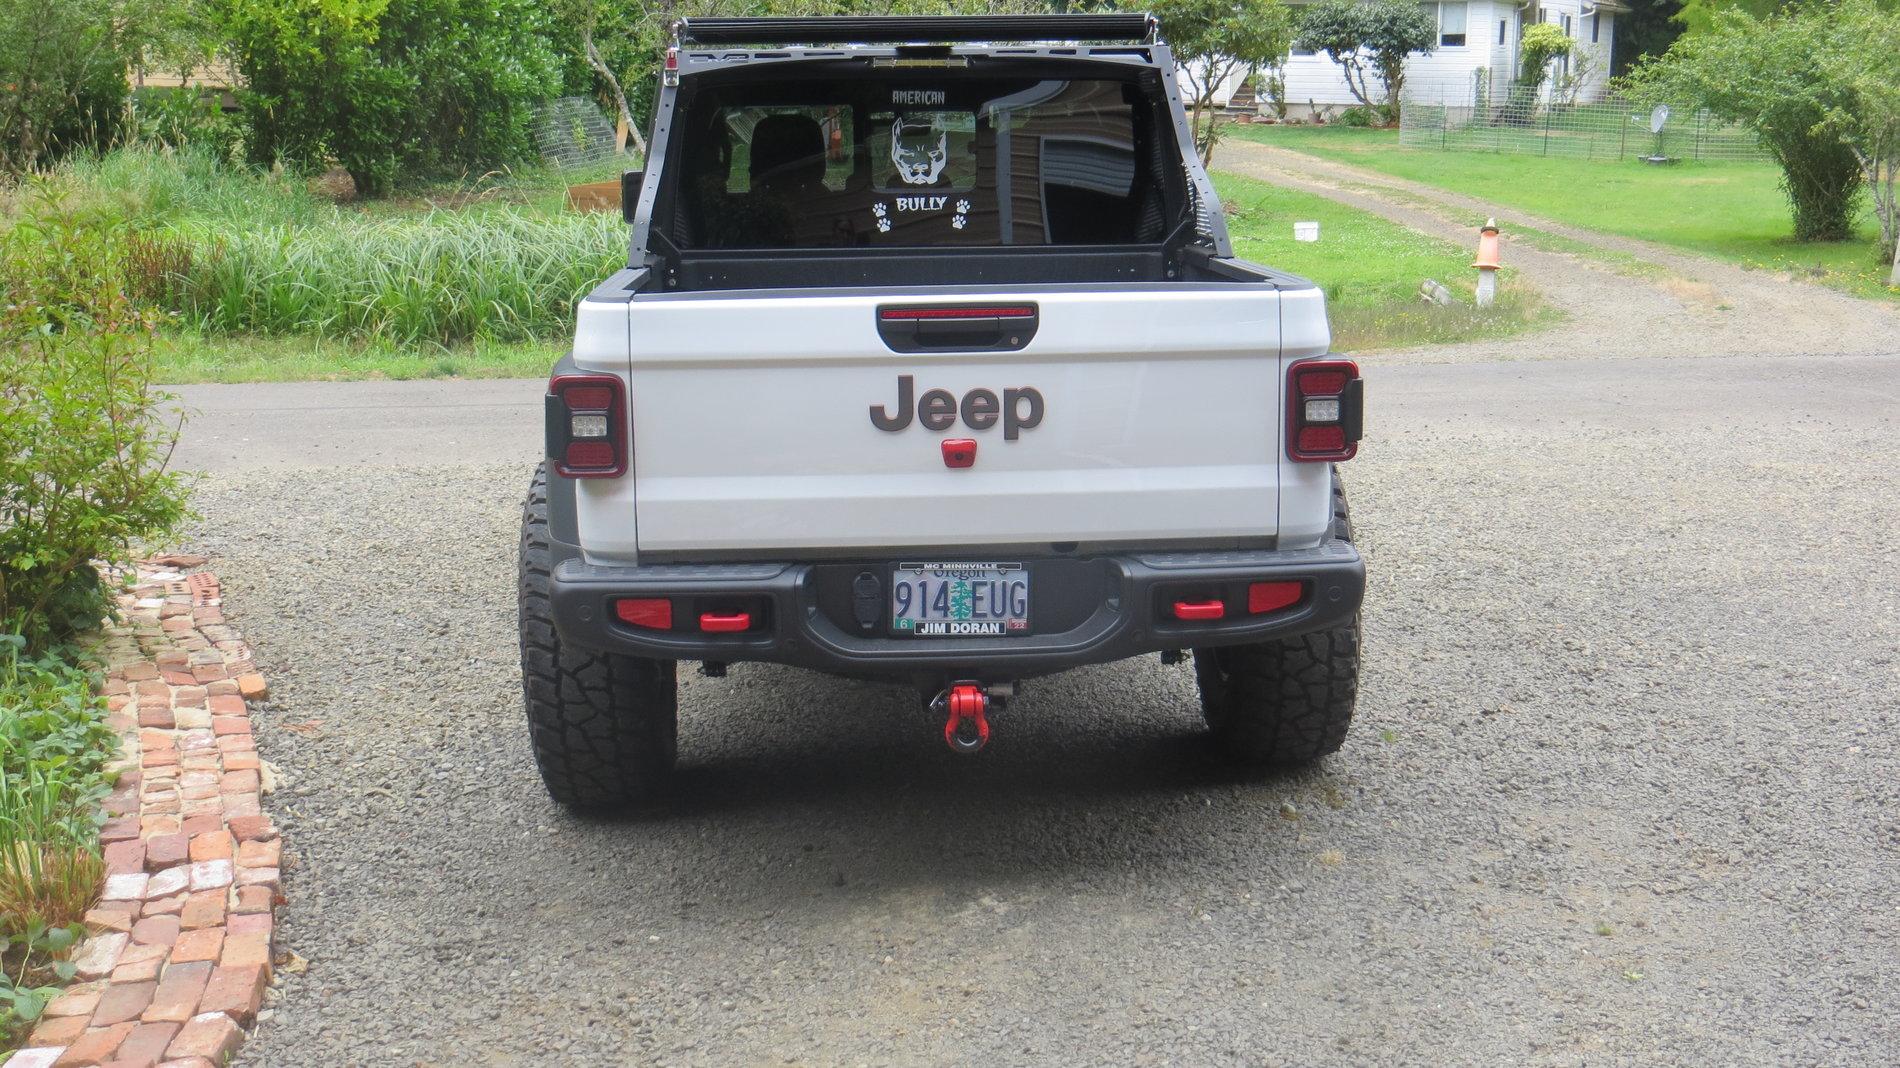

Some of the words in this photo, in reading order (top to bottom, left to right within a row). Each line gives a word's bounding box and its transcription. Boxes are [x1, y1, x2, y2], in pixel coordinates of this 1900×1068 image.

[892, 90, 945, 105] AMERICAN
[896, 196, 948, 211] BULLY
[869, 374, 1045, 441] Jeep
[895, 580, 950, 618] 914
[972, 580, 1026, 619] EUG
[900, 619, 908, 629] 6
[920, 622, 946, 634] JIM
[950, 622, 1000, 634] DORAN
